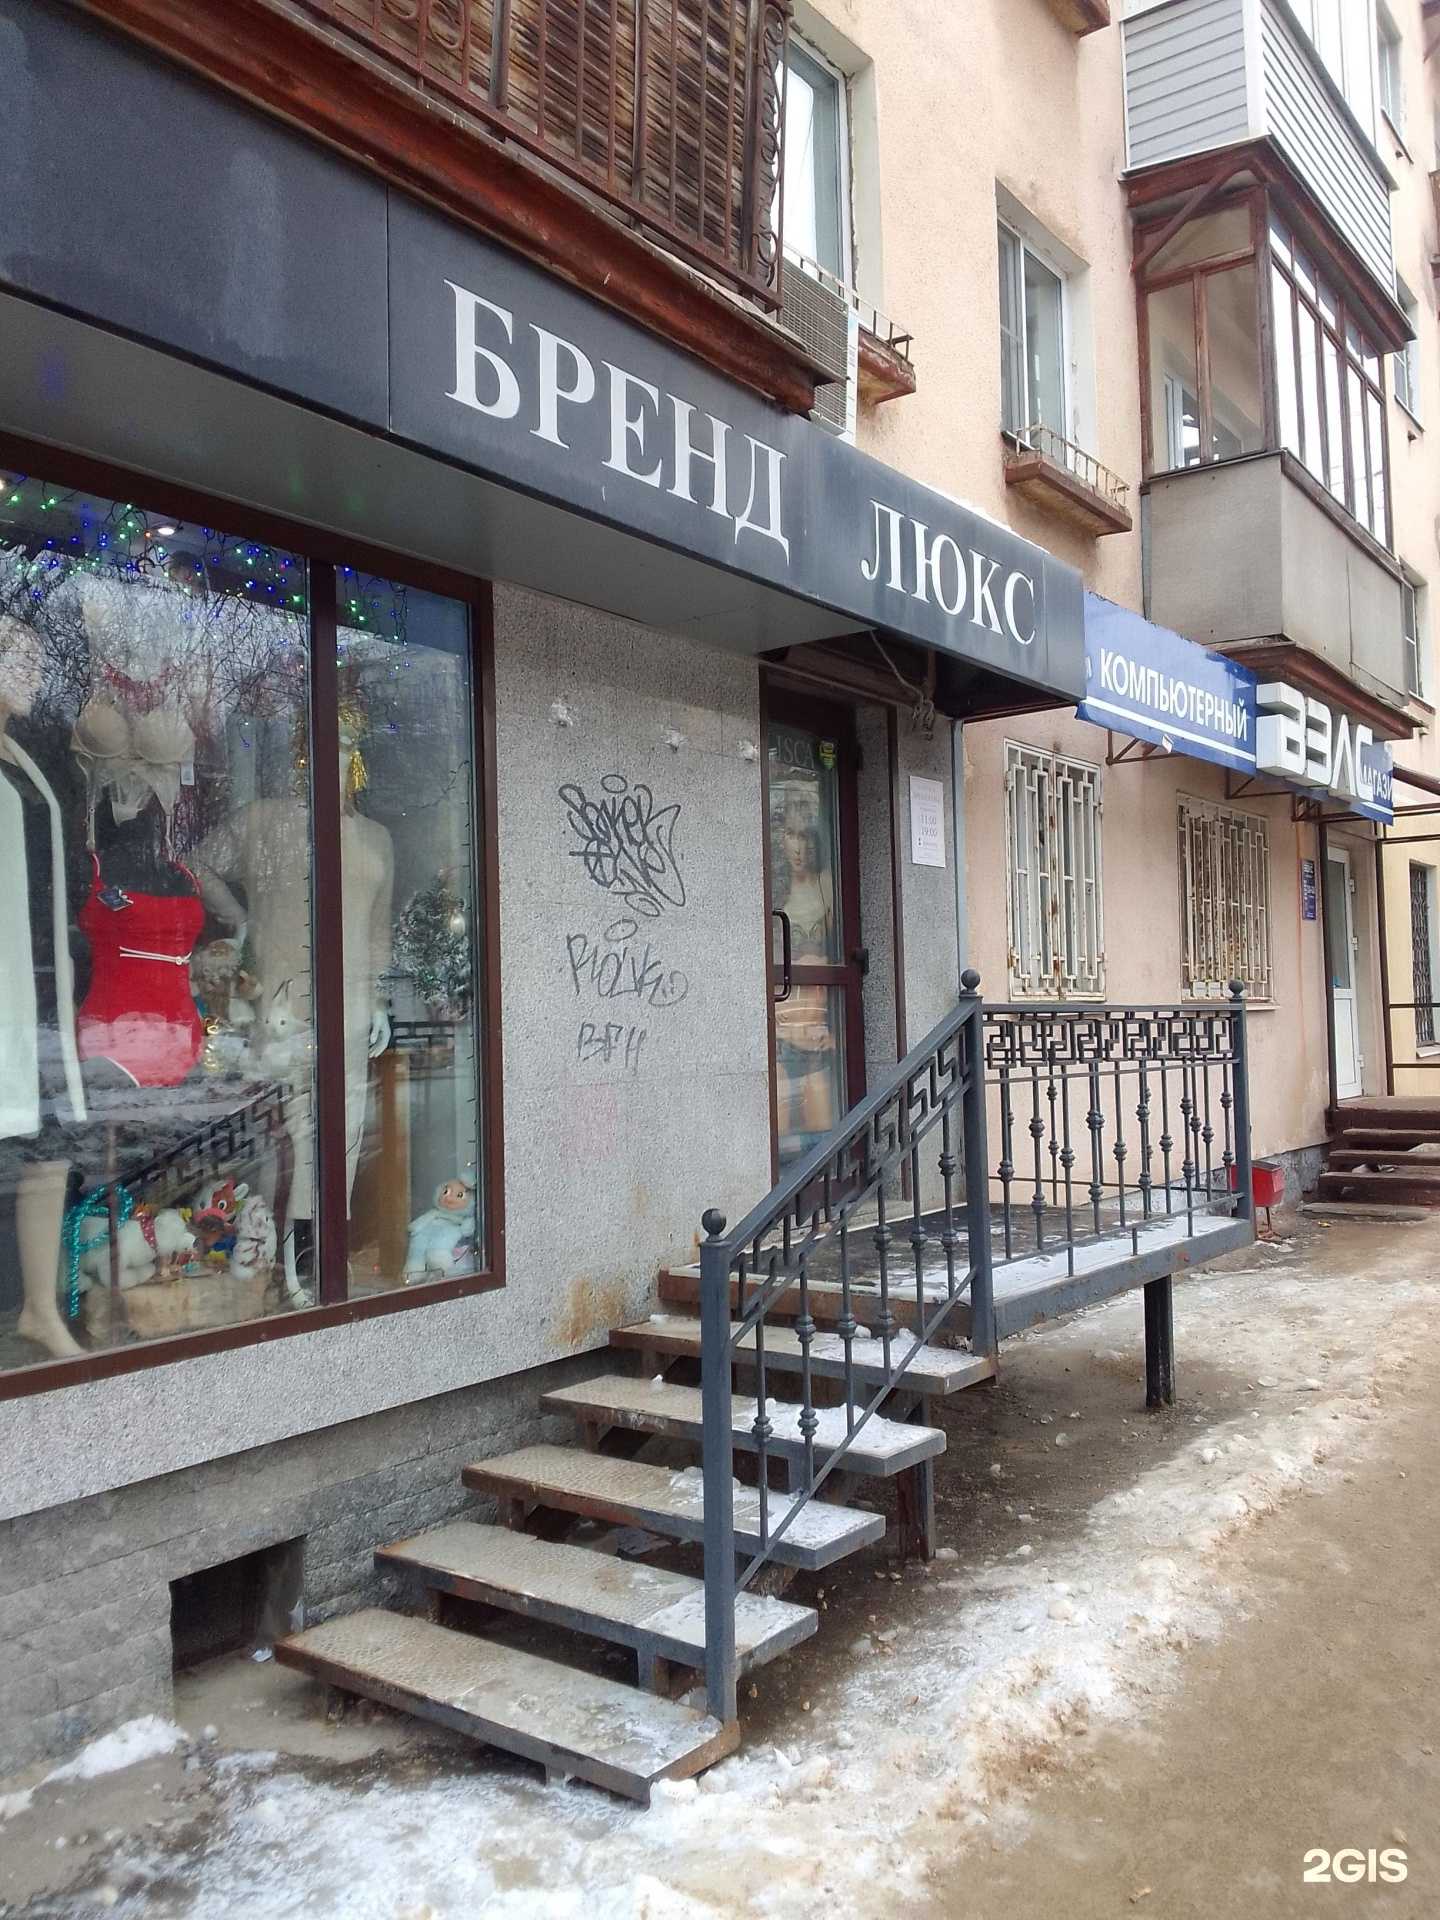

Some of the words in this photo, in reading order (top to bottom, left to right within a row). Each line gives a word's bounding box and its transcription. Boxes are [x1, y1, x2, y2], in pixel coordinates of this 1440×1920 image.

[442, 278, 791, 566] БРЕНД
[860, 498, 1037, 647] ЛЮКС
[1100, 647, 1248, 742] КОМПЬЮТЕРНЫЙ
